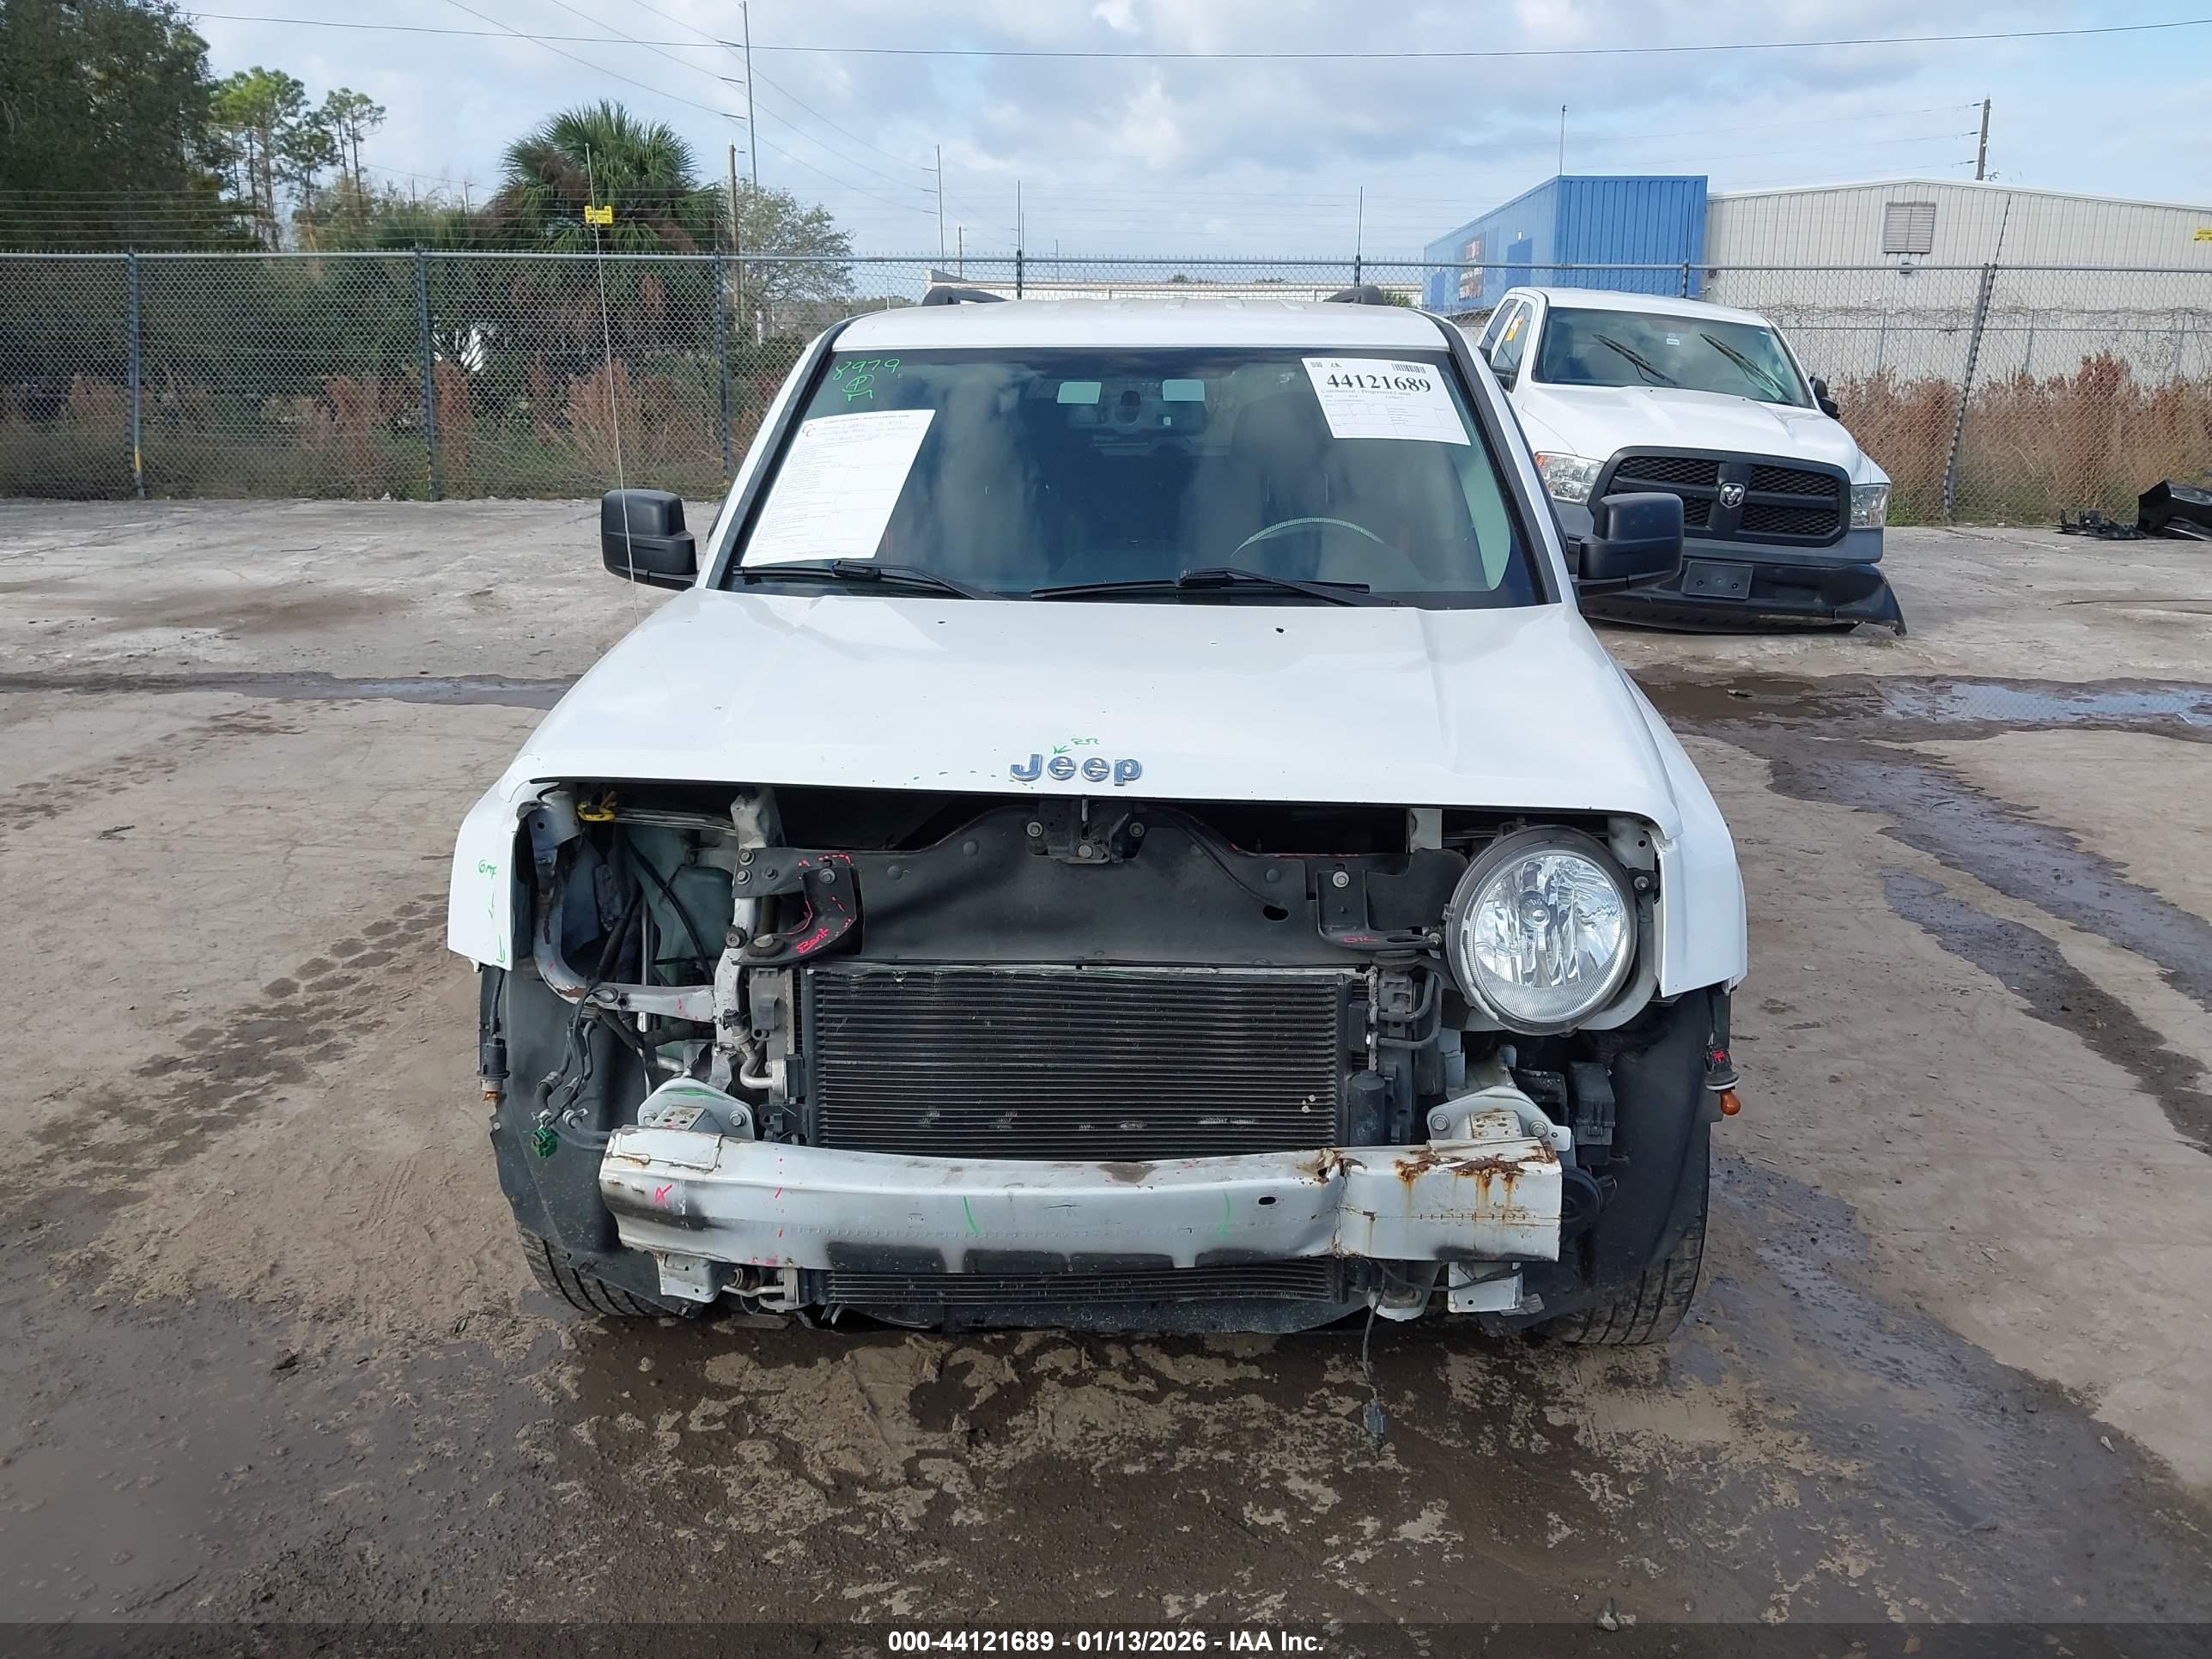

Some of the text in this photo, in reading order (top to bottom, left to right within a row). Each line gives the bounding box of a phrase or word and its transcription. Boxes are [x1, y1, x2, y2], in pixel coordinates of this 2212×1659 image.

[833, 358, 900, 380] 8979
[1327, 373, 1431, 392] 44121689
[1010, 753, 1142, 787] Jeep
